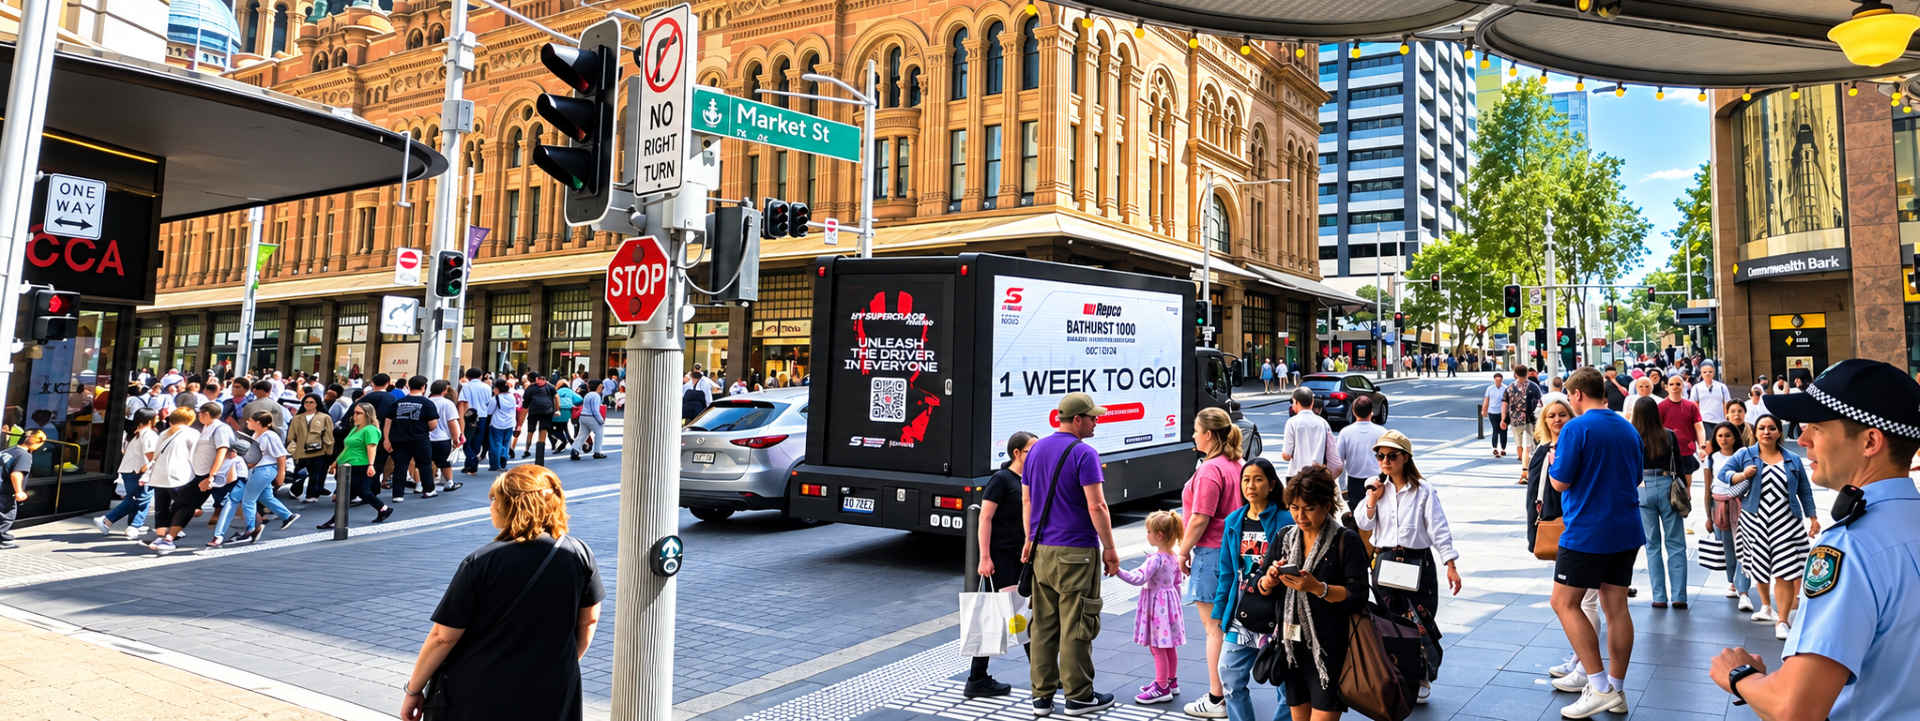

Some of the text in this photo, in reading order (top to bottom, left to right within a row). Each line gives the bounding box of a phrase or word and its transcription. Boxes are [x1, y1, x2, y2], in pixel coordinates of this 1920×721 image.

[650, 100, 674, 130] NO
[737, 103, 830, 143] Market St
[644, 133, 677, 157] RIGHT
[644, 160, 675, 182] TURN
[60, 182, 96, 199] ONE
[56, 199, 95, 215] WAY
[610, 262, 664, 297] STOP
[1096, 303, 1122, 318] Repco
[1066, 320, 1136, 336] BATHURST 1000
[858, 337, 924, 349] UNLEASH
[851, 348, 935, 361] THE DRIVER
[844, 360, 938, 372] IN EVERYONE
[1000, 366, 1176, 397] 1 WEEK TO GO!
